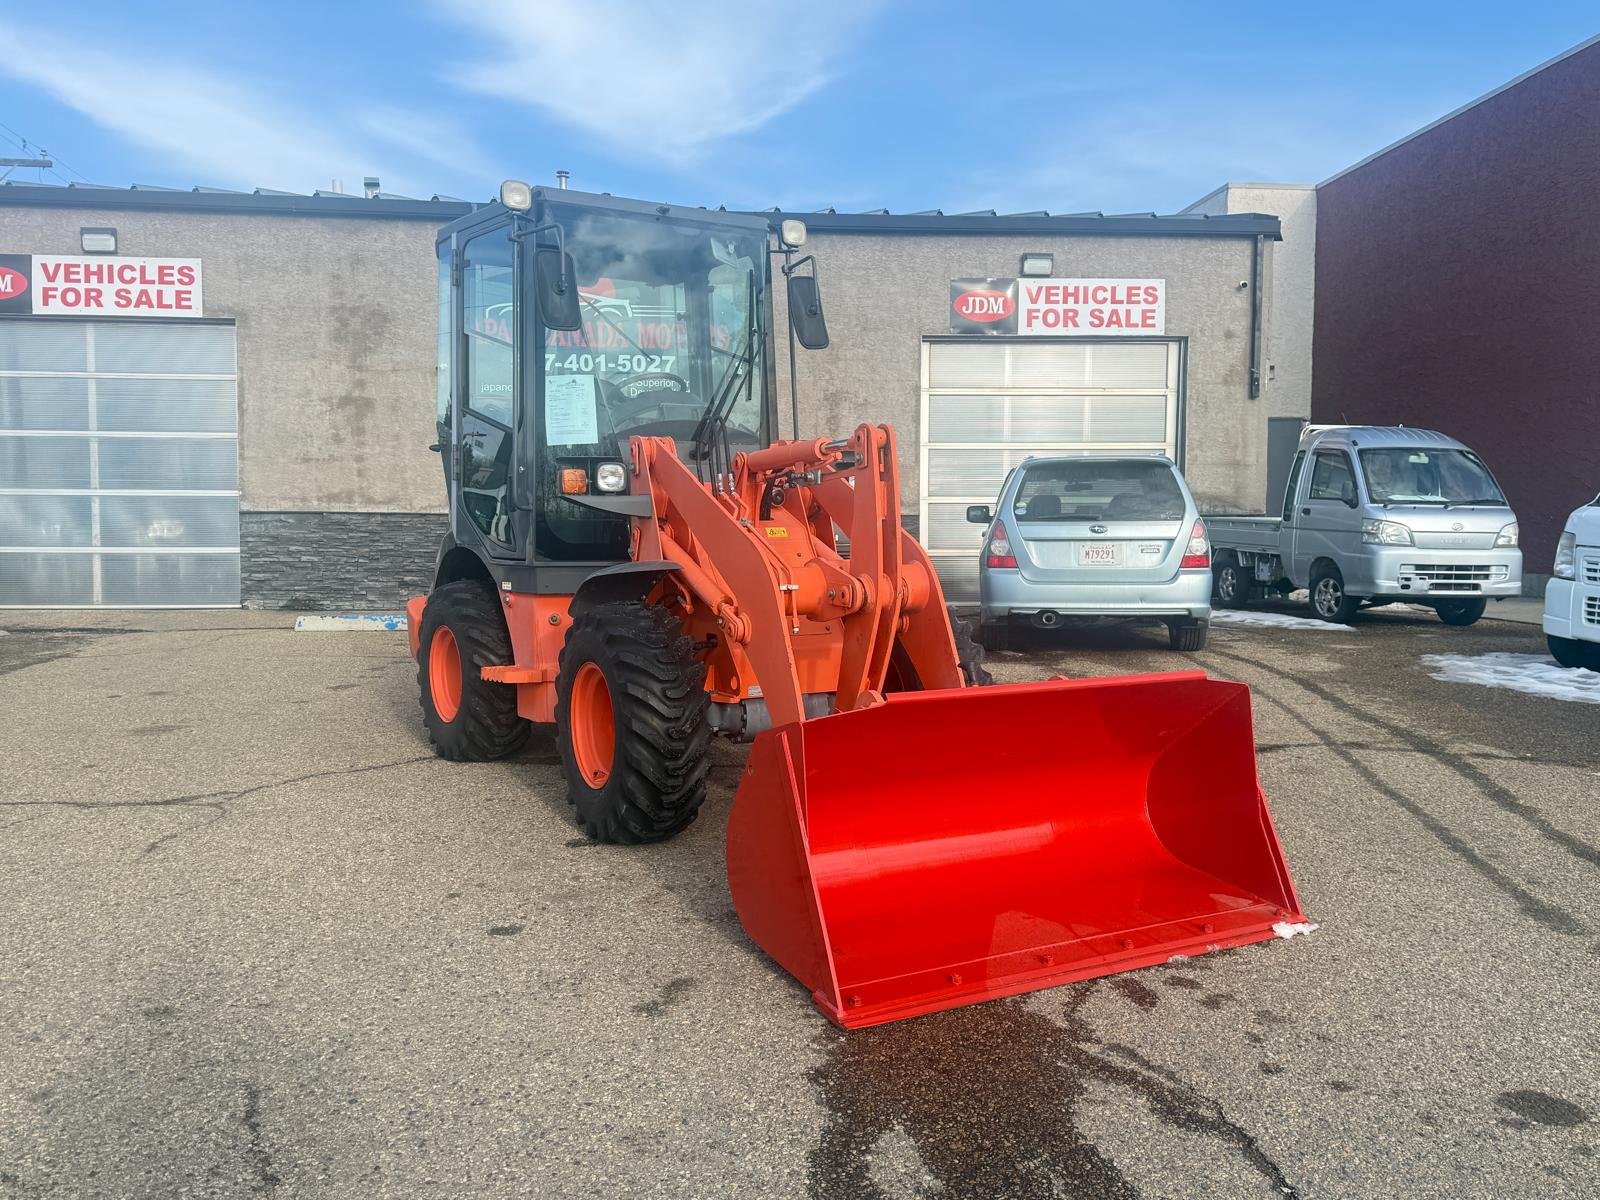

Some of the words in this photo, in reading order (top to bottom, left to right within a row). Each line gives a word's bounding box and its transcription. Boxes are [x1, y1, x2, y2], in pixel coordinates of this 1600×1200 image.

[40, 263, 196, 286] VEHICLES
[42, 287, 104, 308] FOR
[114, 288, 193, 310] SALE
[1025, 285, 1159, 305] VEHICLES
[962, 296, 1005, 315] JDM
[1026, 308, 1081, 328] FOR
[1088, 308, 1156, 328] SALE
[545, 320, 630, 348] ANADA
[636, 320, 730, 352] MOTS
[545, 353, 677, 373] 7-401-5027
[480, 383, 513, 393] japanc
[636, 378, 675, 389] Superior
